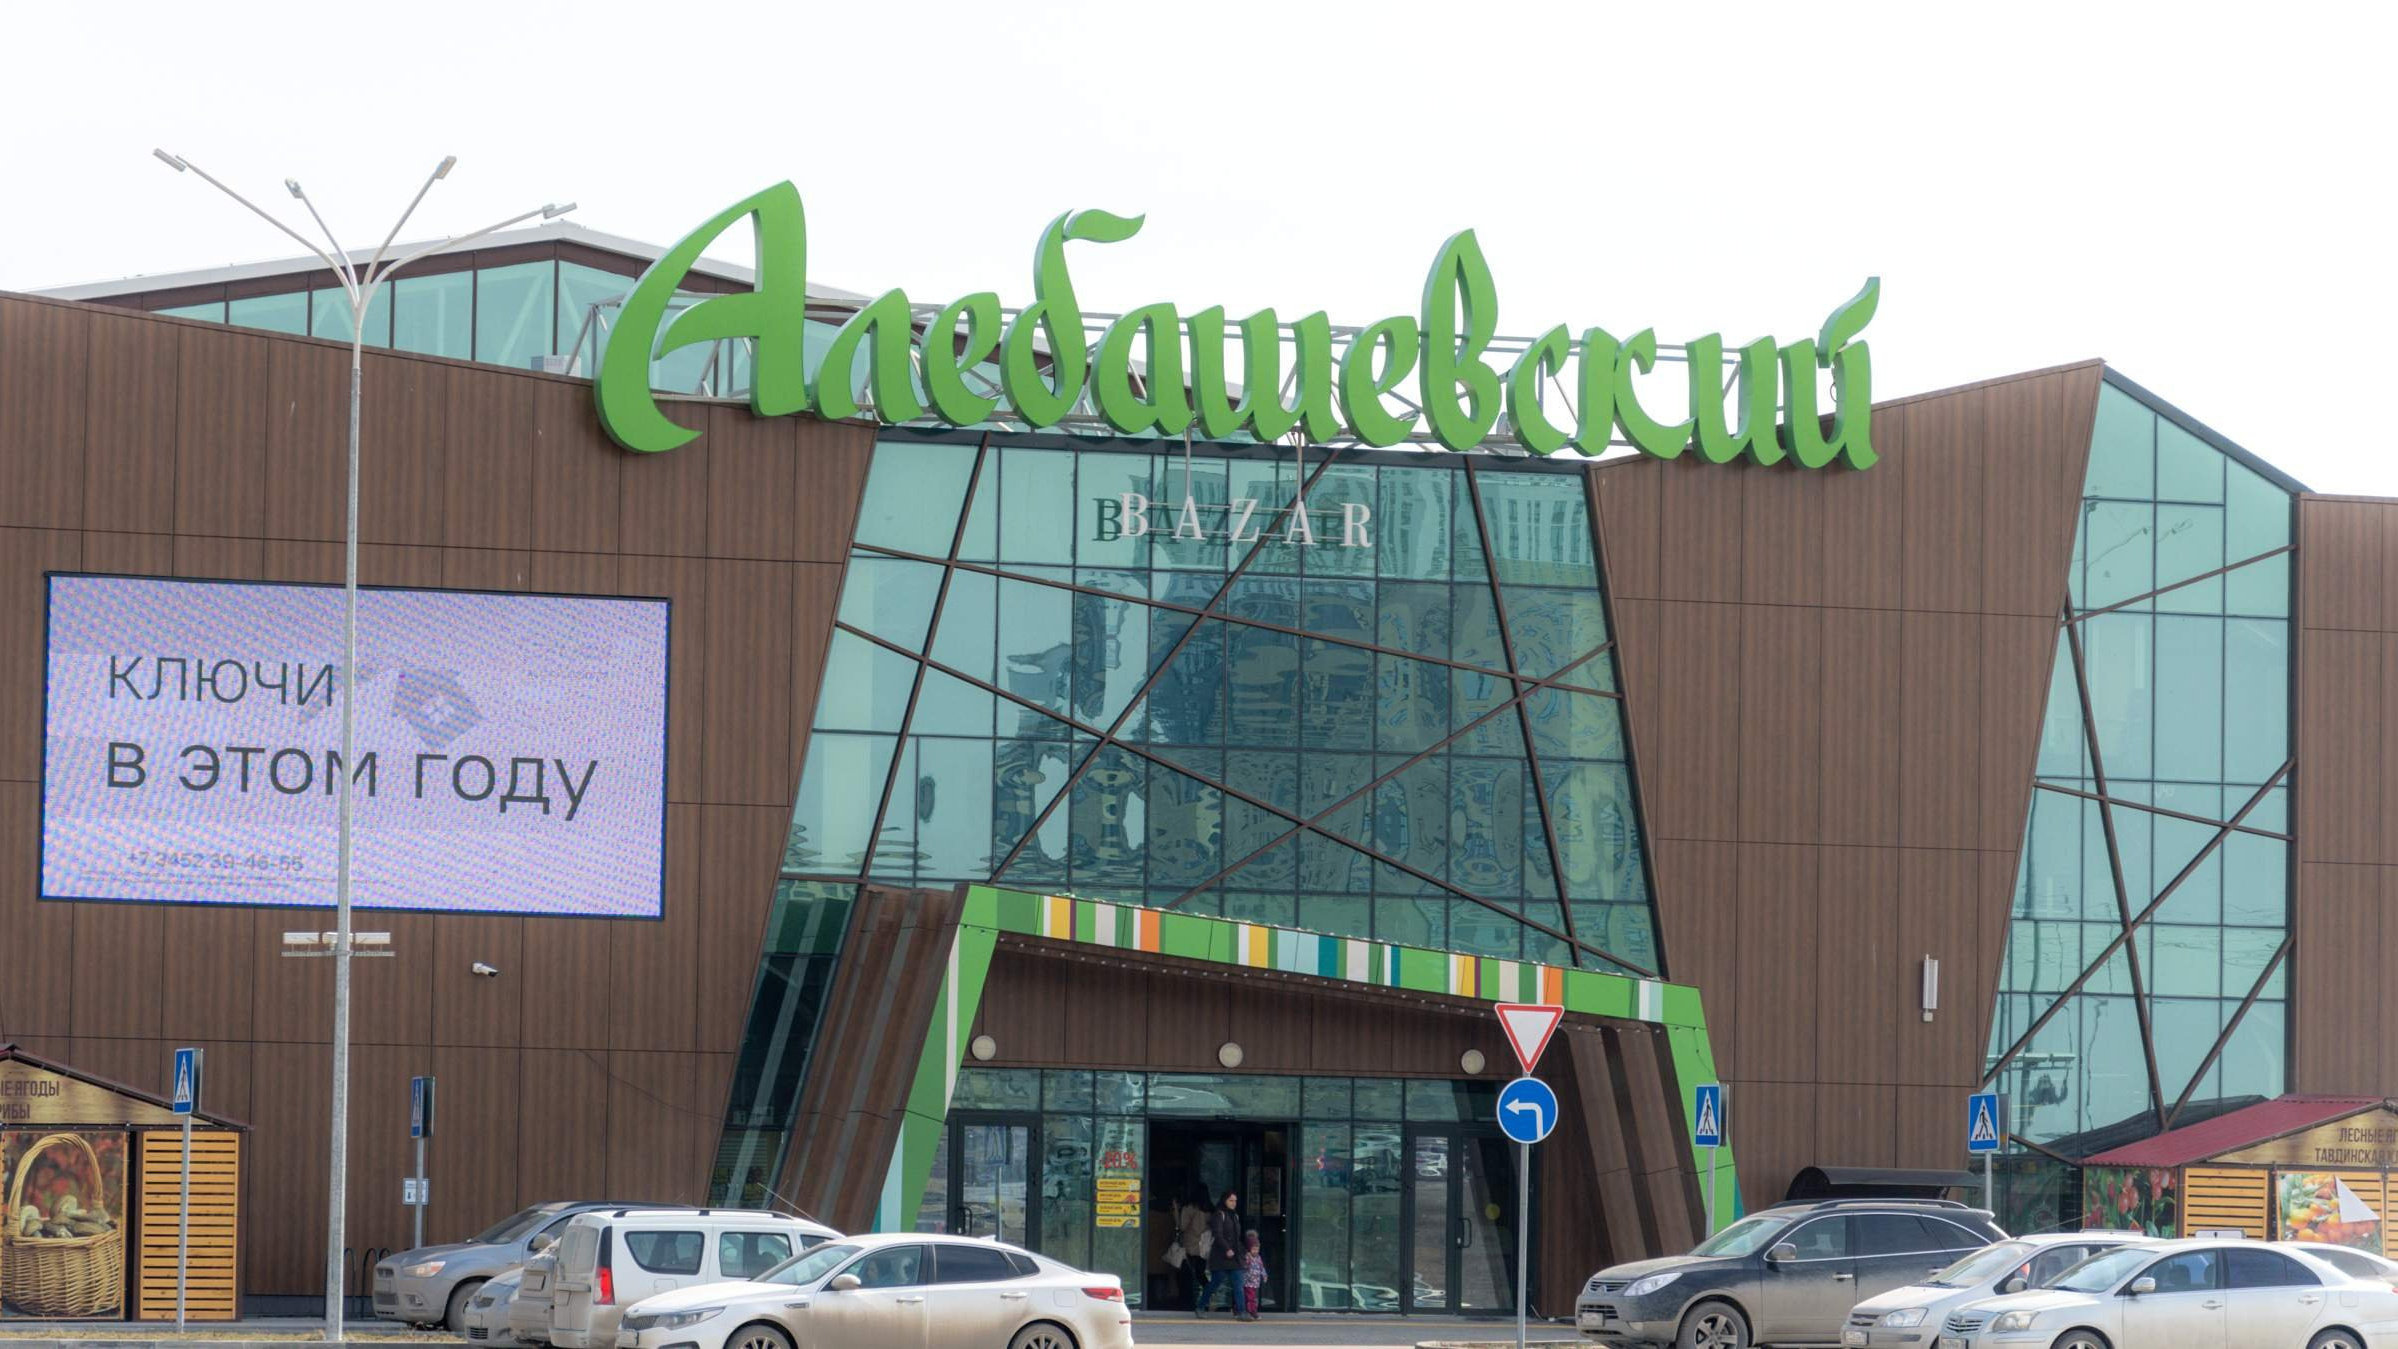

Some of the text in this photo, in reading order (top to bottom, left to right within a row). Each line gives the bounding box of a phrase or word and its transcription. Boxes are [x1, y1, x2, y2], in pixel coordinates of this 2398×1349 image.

[593, 180, 1881, 471] Алебашевский
[1118, 492, 1373, 548] BAZAR
[109, 654, 334, 707] КЛЮЧИ
[106, 741, 599, 821] В ЭТОМ ГОДУ
[14, 1080, 60, 1098] ЯГОДЫ
[2338, 1127, 2383, 1143] ЛЕСНЫЕ
